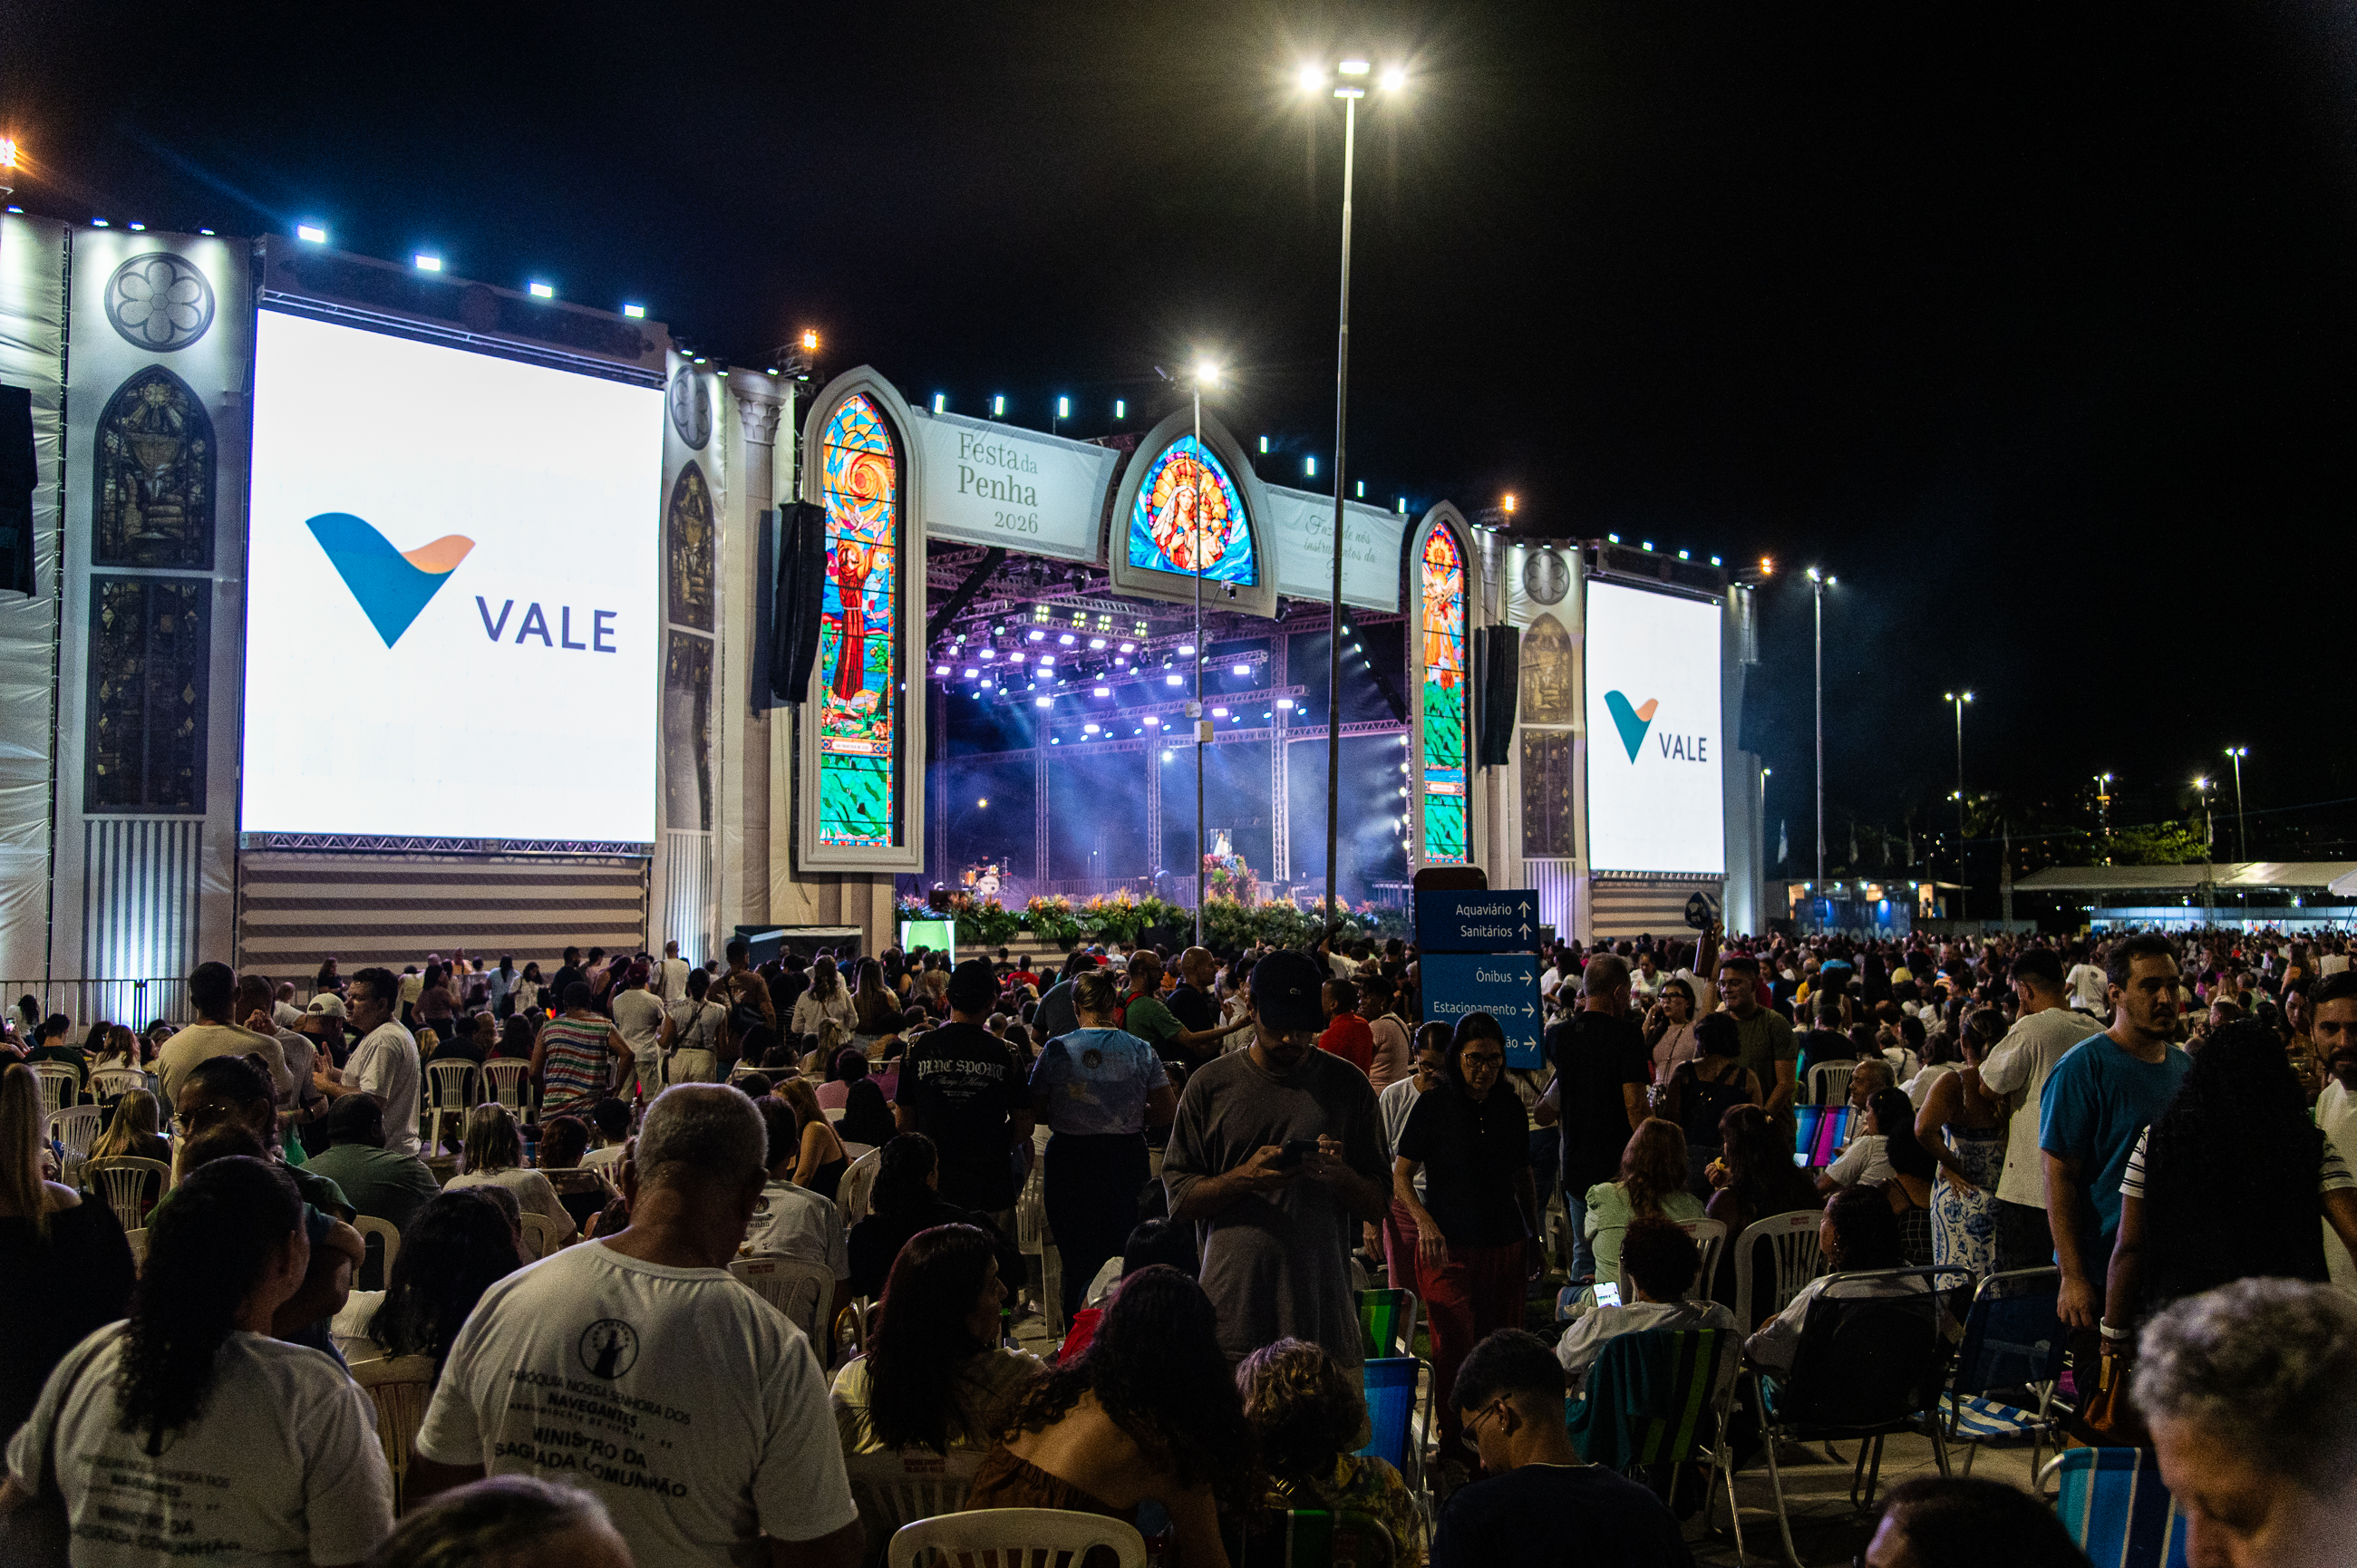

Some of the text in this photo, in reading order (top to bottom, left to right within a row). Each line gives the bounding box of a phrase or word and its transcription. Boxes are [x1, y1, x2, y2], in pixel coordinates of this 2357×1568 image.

[958, 431, 1038, 475] Festa da
[957, 464, 1038, 507] Penha
[994, 511, 1038, 534] 2026
[1305, 515, 1335, 537] Faz
[1305, 537, 1362, 560] instruntos
[475, 595, 618, 653] VALE
[1658, 732, 1707, 763] VALE
[1456, 904, 1512, 918] Aquaviário
[1460, 924, 1513, 937] Sanitários
[1476, 967, 1512, 982] Ônibus
[1433, 1002, 1517, 1016] Estacionamento
[567, 1379, 607, 1398] NOSSA
[664, 1407, 692, 1426] DOS
[624, 1447, 647, 1468] DA
